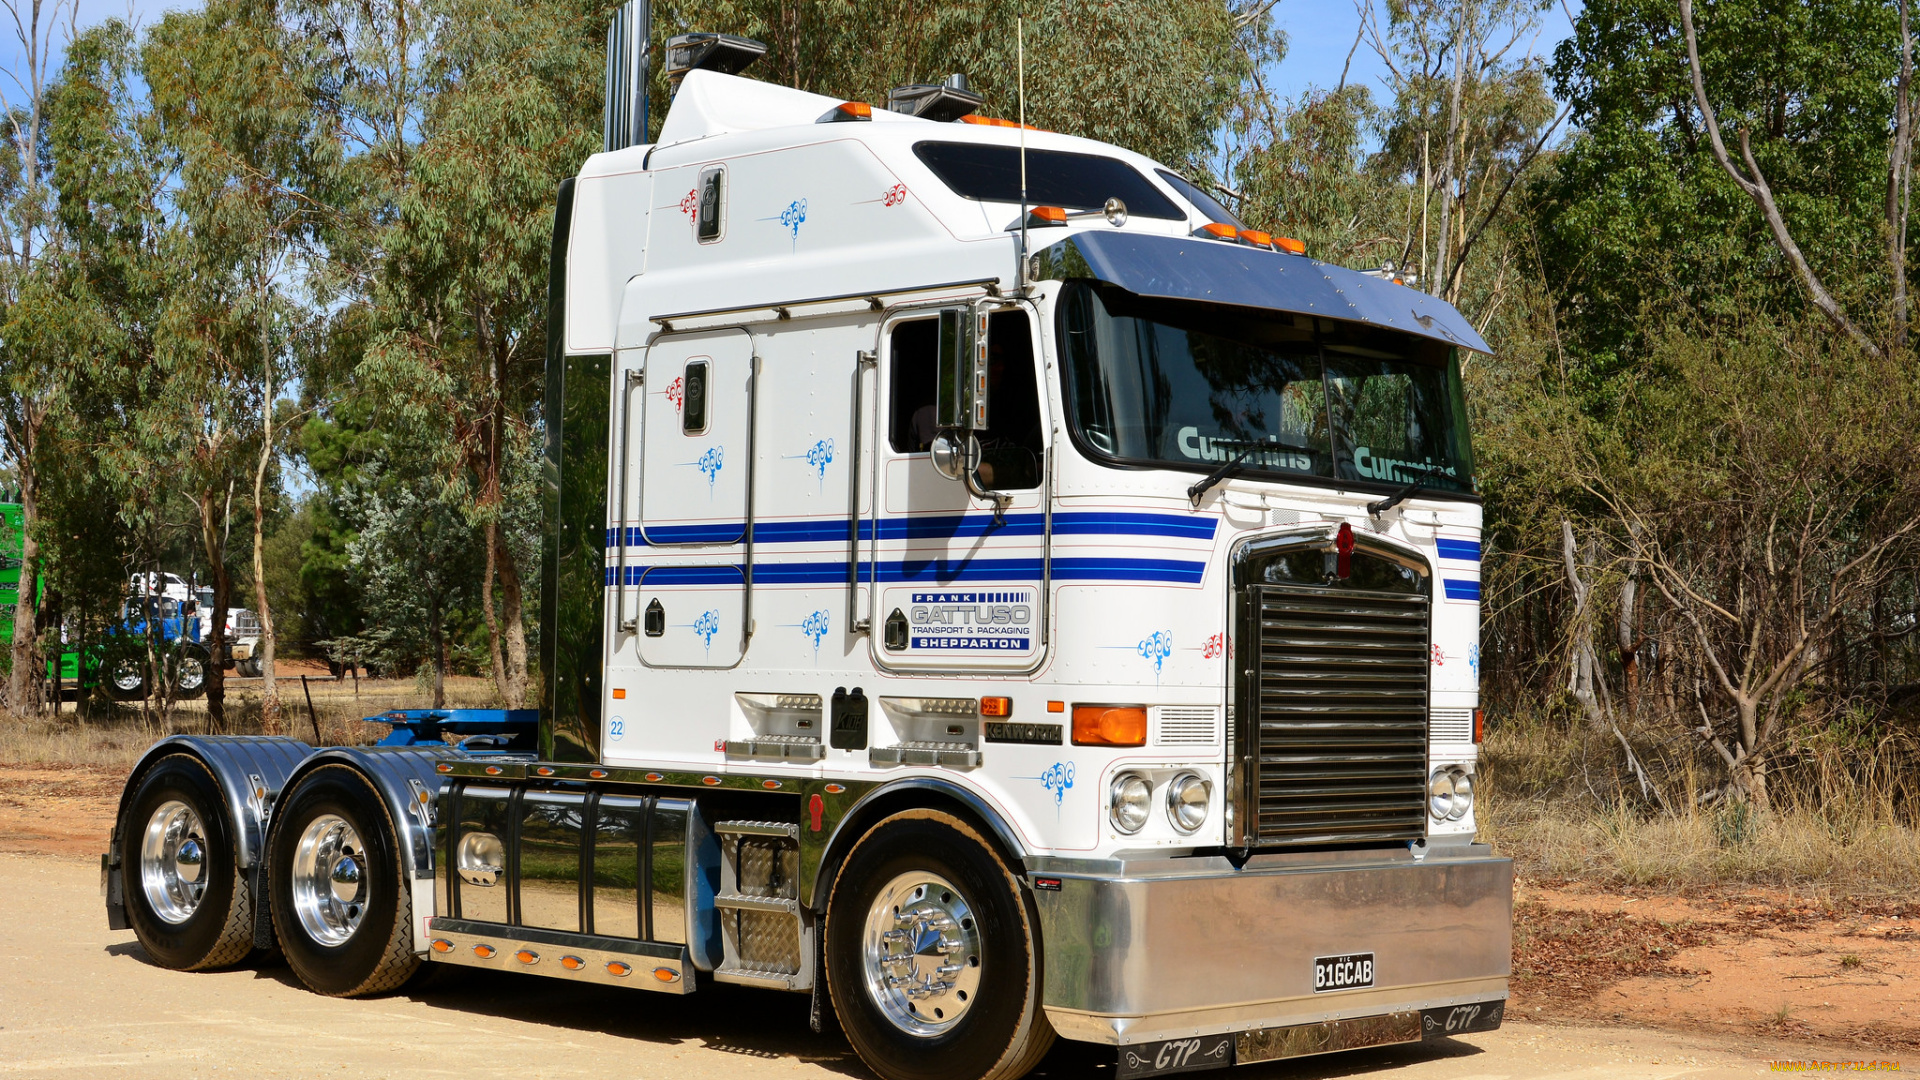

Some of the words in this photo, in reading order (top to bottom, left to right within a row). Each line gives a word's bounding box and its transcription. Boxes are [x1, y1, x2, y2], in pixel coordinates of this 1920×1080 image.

[915, 594, 971, 602] FRANK
[911, 604, 1031, 625] GATTUSO
[912, 626, 965, 634] TRANSPORT
[967, 626, 974, 634] &
[977, 626, 1030, 635] PACKAGING
[919, 638, 1021, 649] SHEPPARTON
[610, 721, 623, 735] 22
[985, 722, 1062, 740] KENWORTH
[1316, 960, 1373, 988] B1GCAB
[1445, 1005, 1481, 1031] GTP
[1155, 1039, 1201, 1069] GTP
